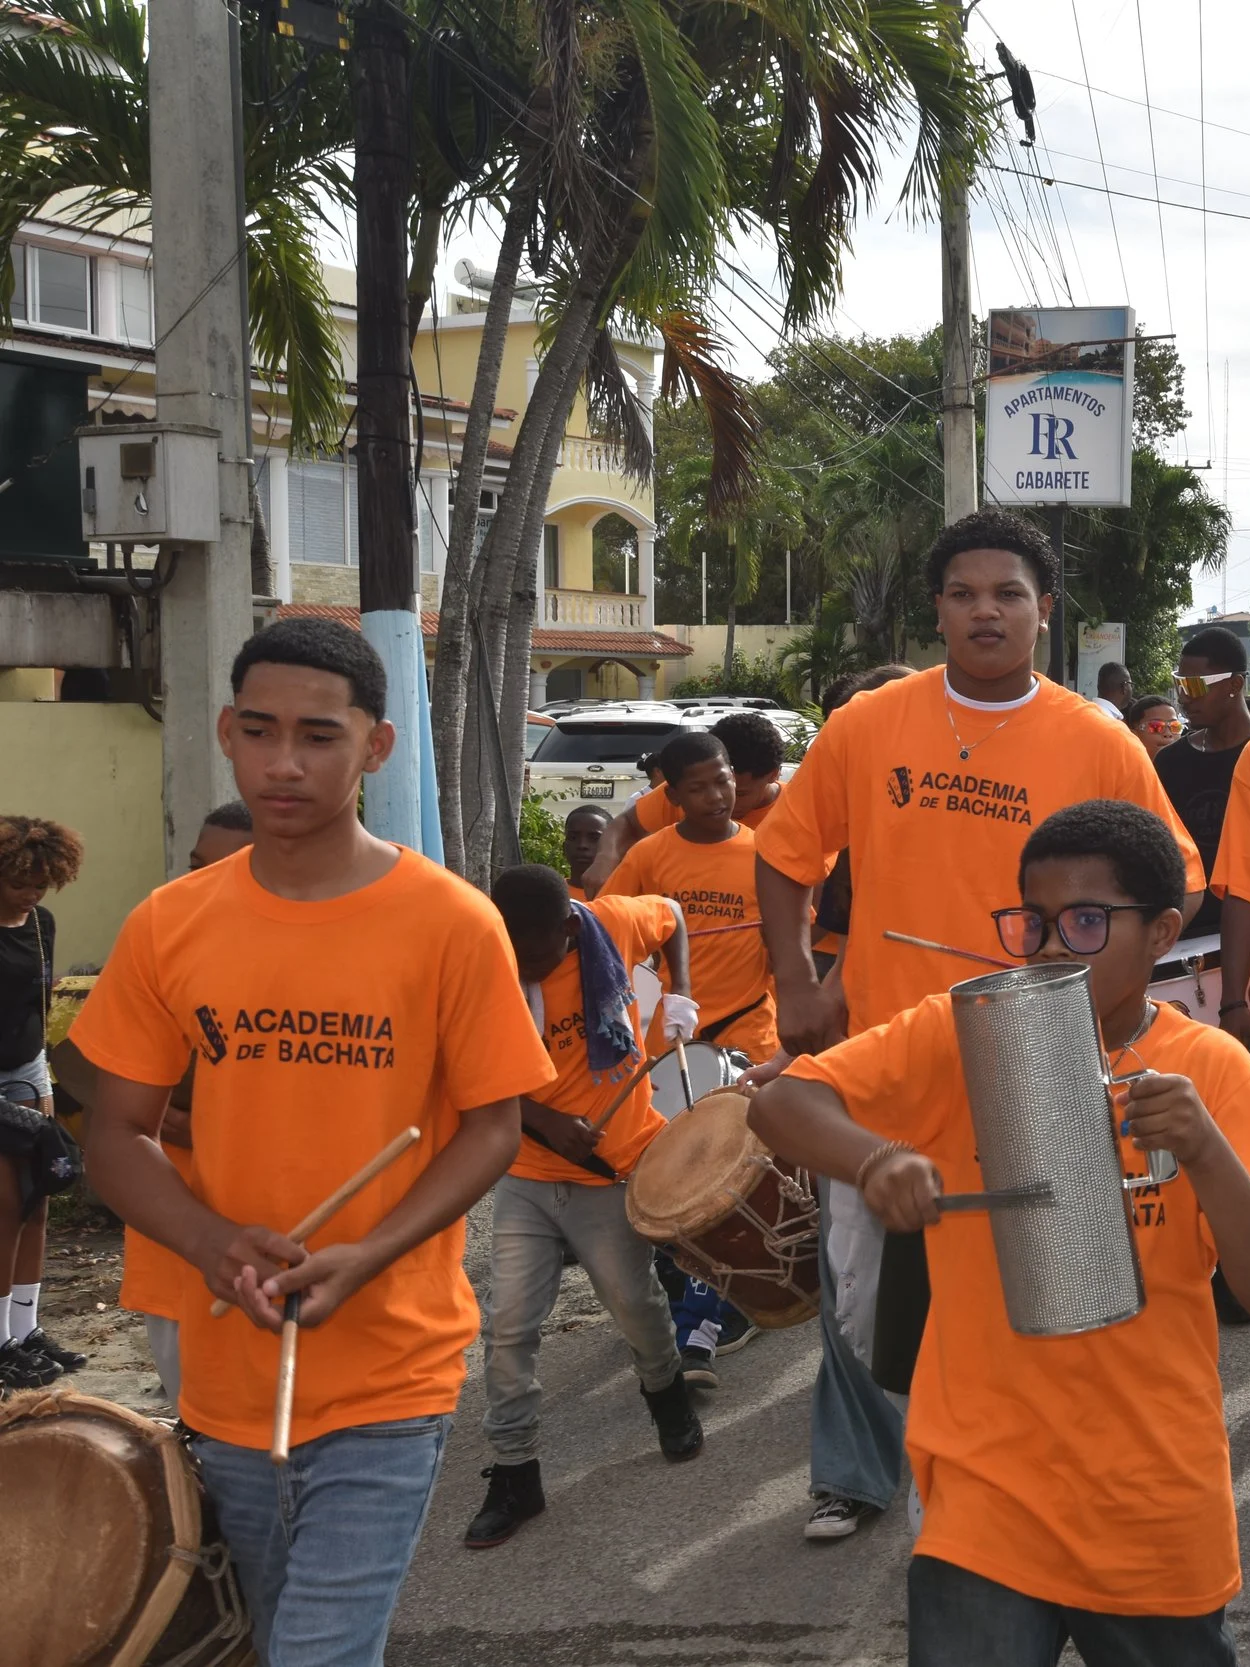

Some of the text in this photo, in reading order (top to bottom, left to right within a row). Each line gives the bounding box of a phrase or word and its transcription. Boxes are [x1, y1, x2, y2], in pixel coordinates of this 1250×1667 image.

[1003, 386, 1106, 419] APARTAMENTOS
[1016, 471, 1090, 490] CABARETE
[919, 771, 1029, 805] ACADEMIA
[919, 795, 1032, 826] DE BACHATA
[672, 890, 744, 907] ACADEMIA
[687, 903, 745, 920] BACHATA
[234, 1008, 393, 1041] ACADEMIA
[236, 1039, 395, 1069] DE BACHATA
[558, 1036, 574, 1050] DE
